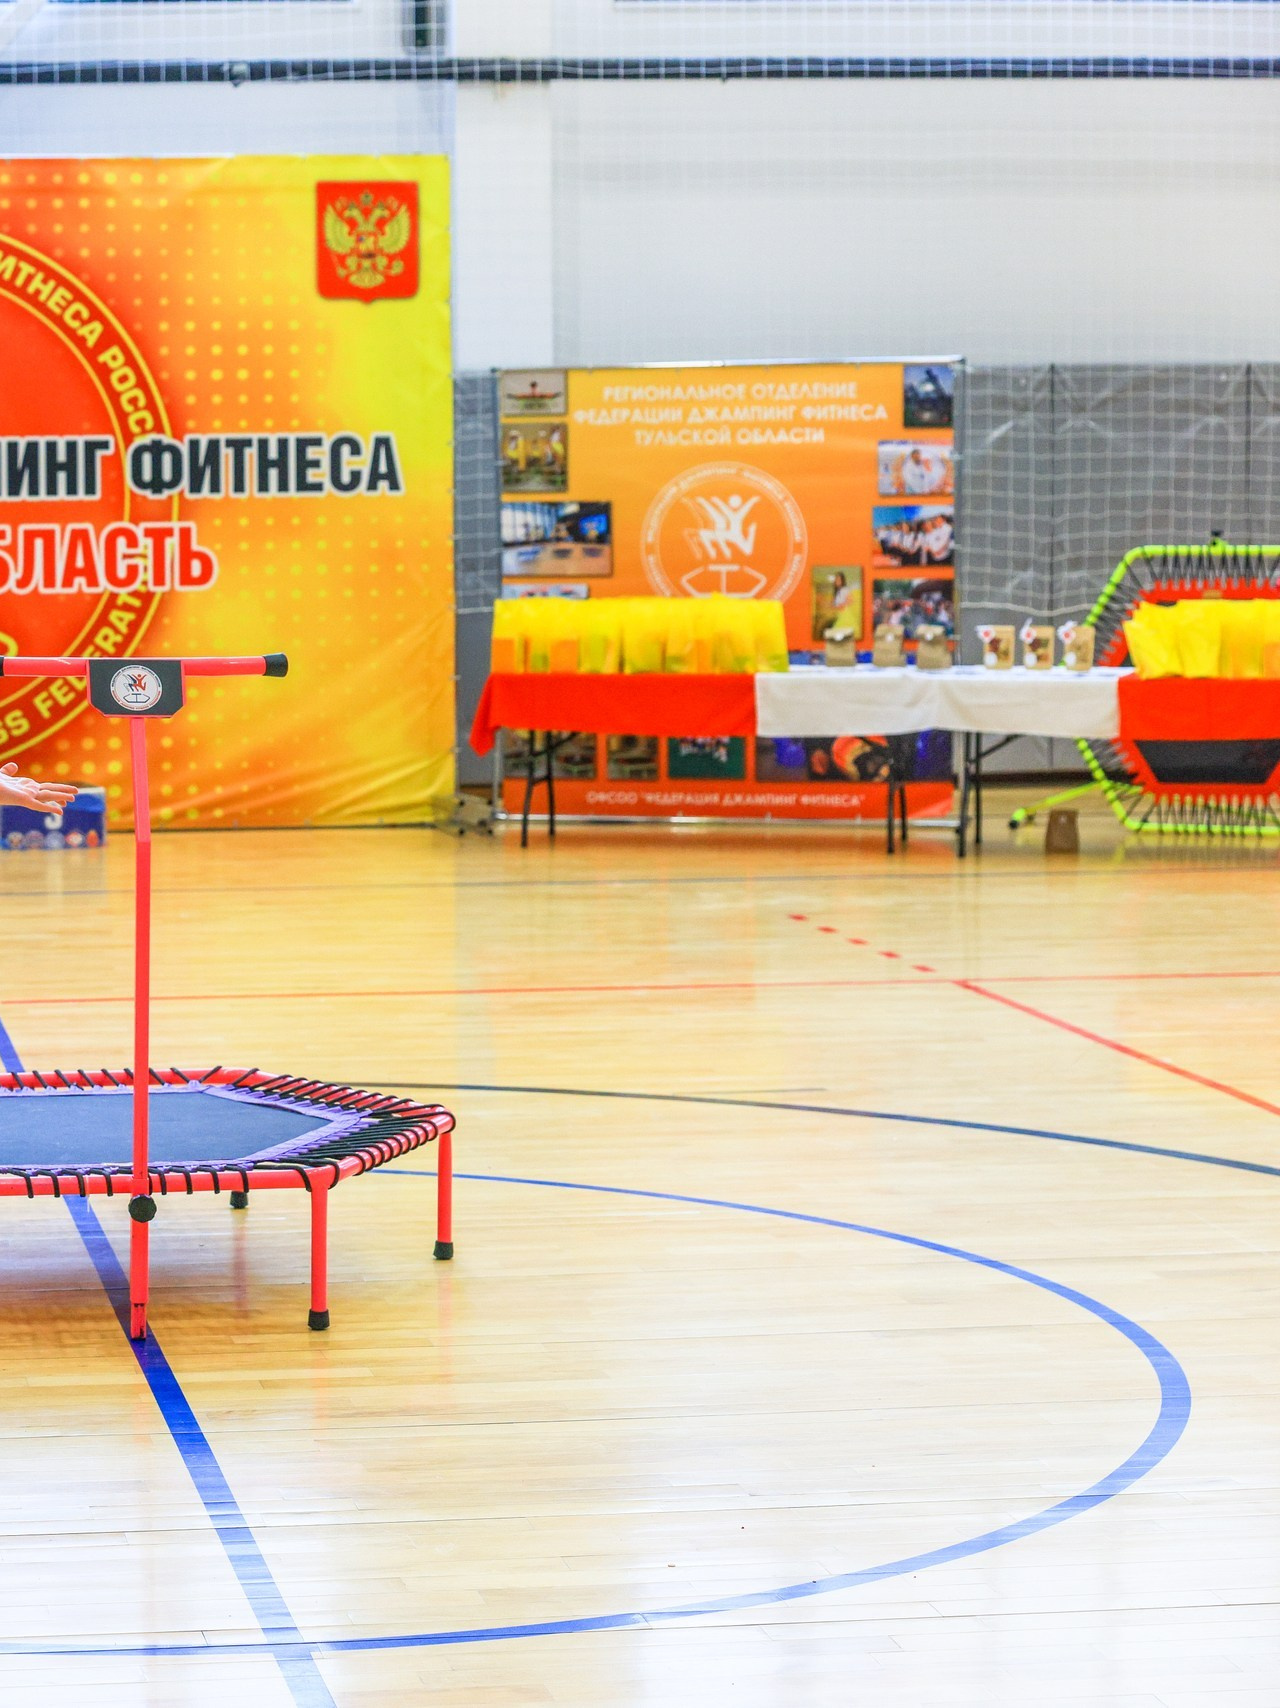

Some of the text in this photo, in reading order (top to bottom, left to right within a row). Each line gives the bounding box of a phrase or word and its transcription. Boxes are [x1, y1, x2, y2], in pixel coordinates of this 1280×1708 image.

[96, 345, 158, 442] РОСС
[603, 382, 857, 402] РЕГИОНАЛЬНОЕ ОТДЕЛЕНИЕ
[573, 404, 888, 426] ФЕДЕРАЦИИ ДЖАМПИНГ ФИТНЕСА
[634, 426, 825, 446] ТУЛЬСКОЙ ОБЛАСТИ
[130, 434, 402, 498] ФИТНЕСА
